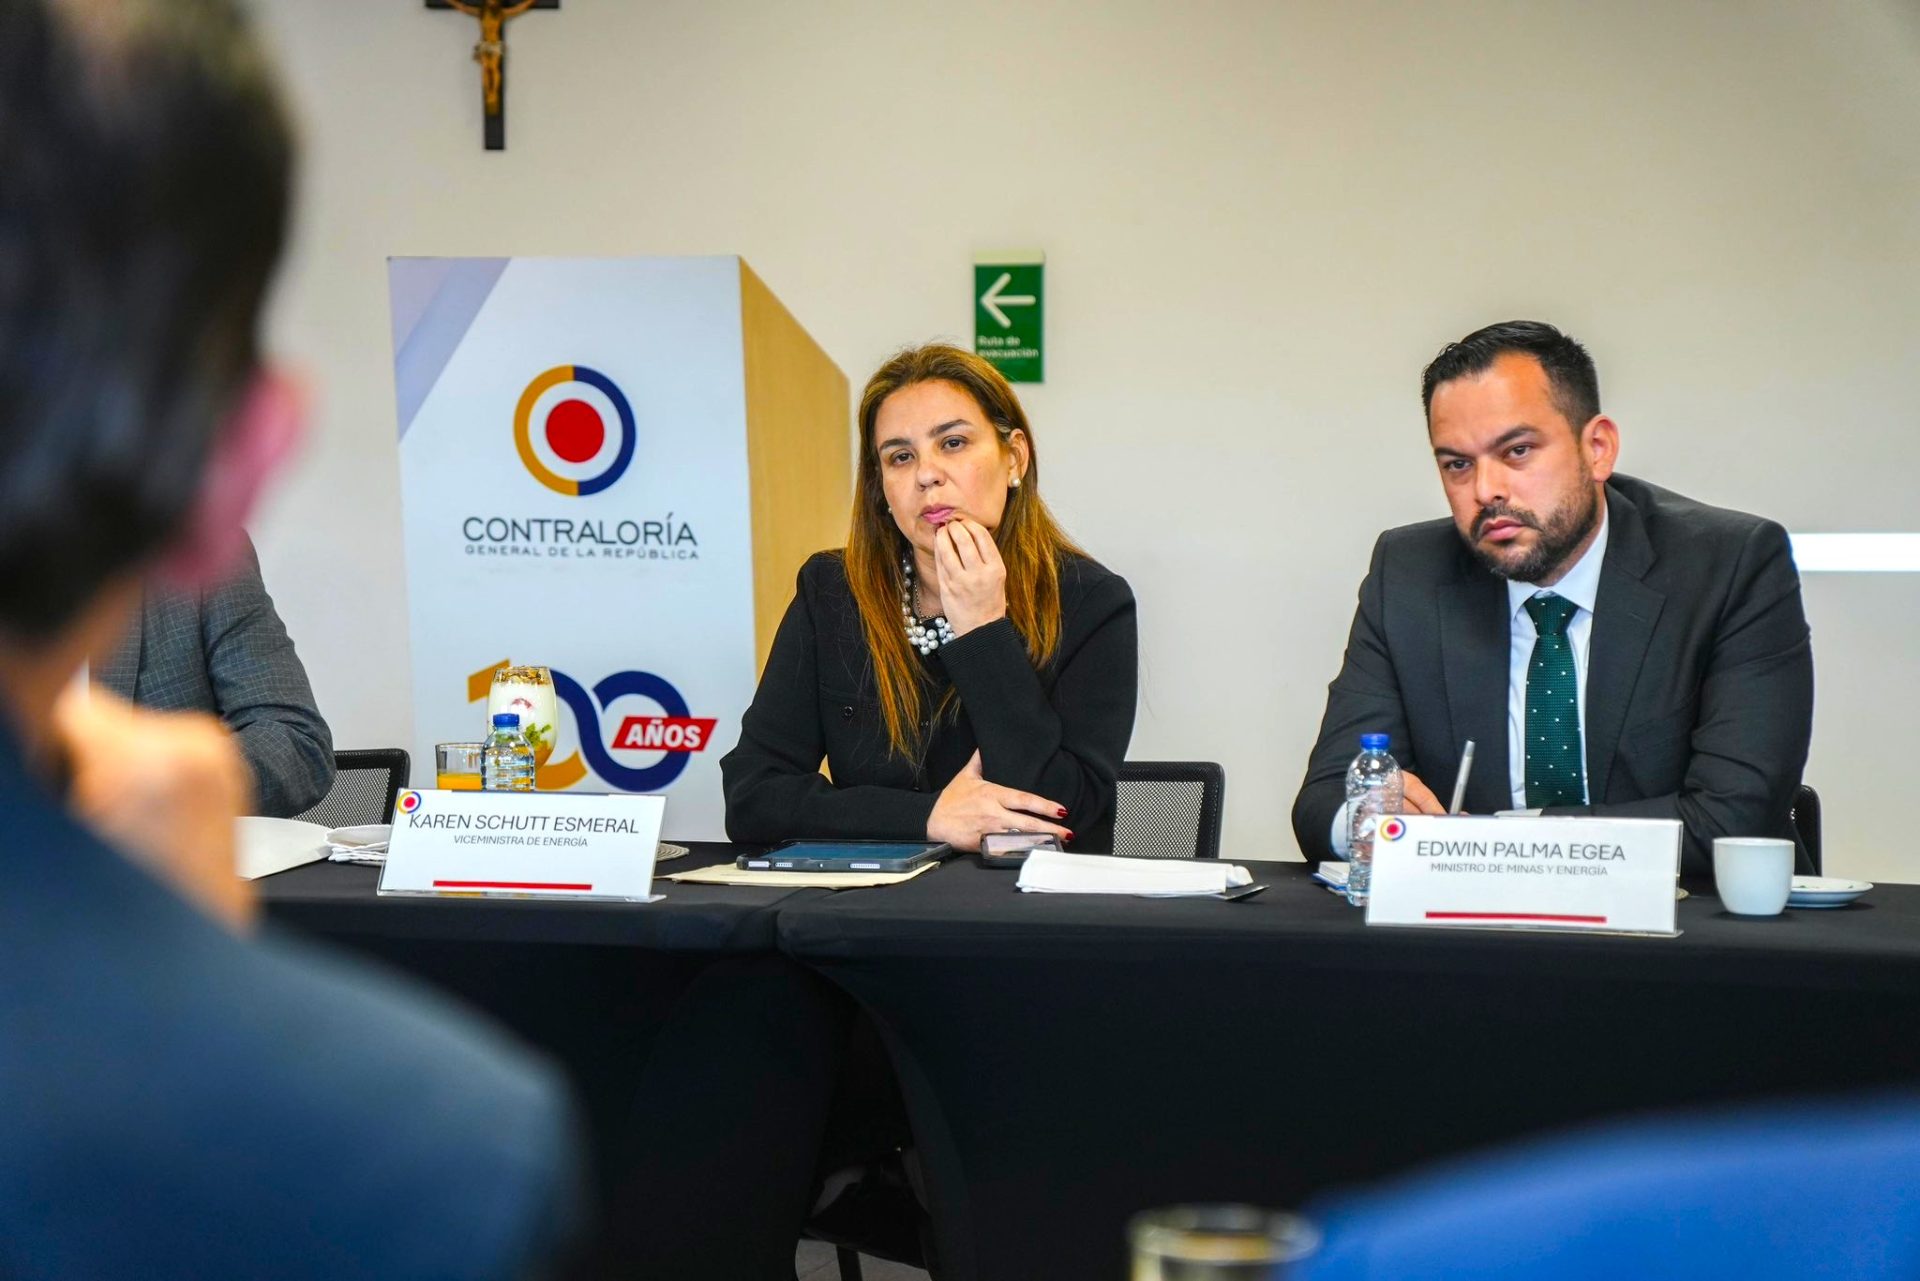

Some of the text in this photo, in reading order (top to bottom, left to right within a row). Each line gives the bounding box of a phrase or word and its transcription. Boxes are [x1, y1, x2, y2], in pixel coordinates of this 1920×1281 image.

[463, 512, 698, 546] CONTRALORÍA
[465, 545, 699, 560] GENERAL DE LA REPÚBLICA
[624, 719, 701, 748] AÑOS
[409, 814, 639, 833] KAREN SCHUTT ESMERAL
[454, 835, 588, 847] VICEMINISTRA DE ENERGÍA
[1417, 841, 1626, 861] EDWIN PALMA EGEA
[1431, 863, 1608, 876] MINISTRO DE MINAS Y ENERGÍA
